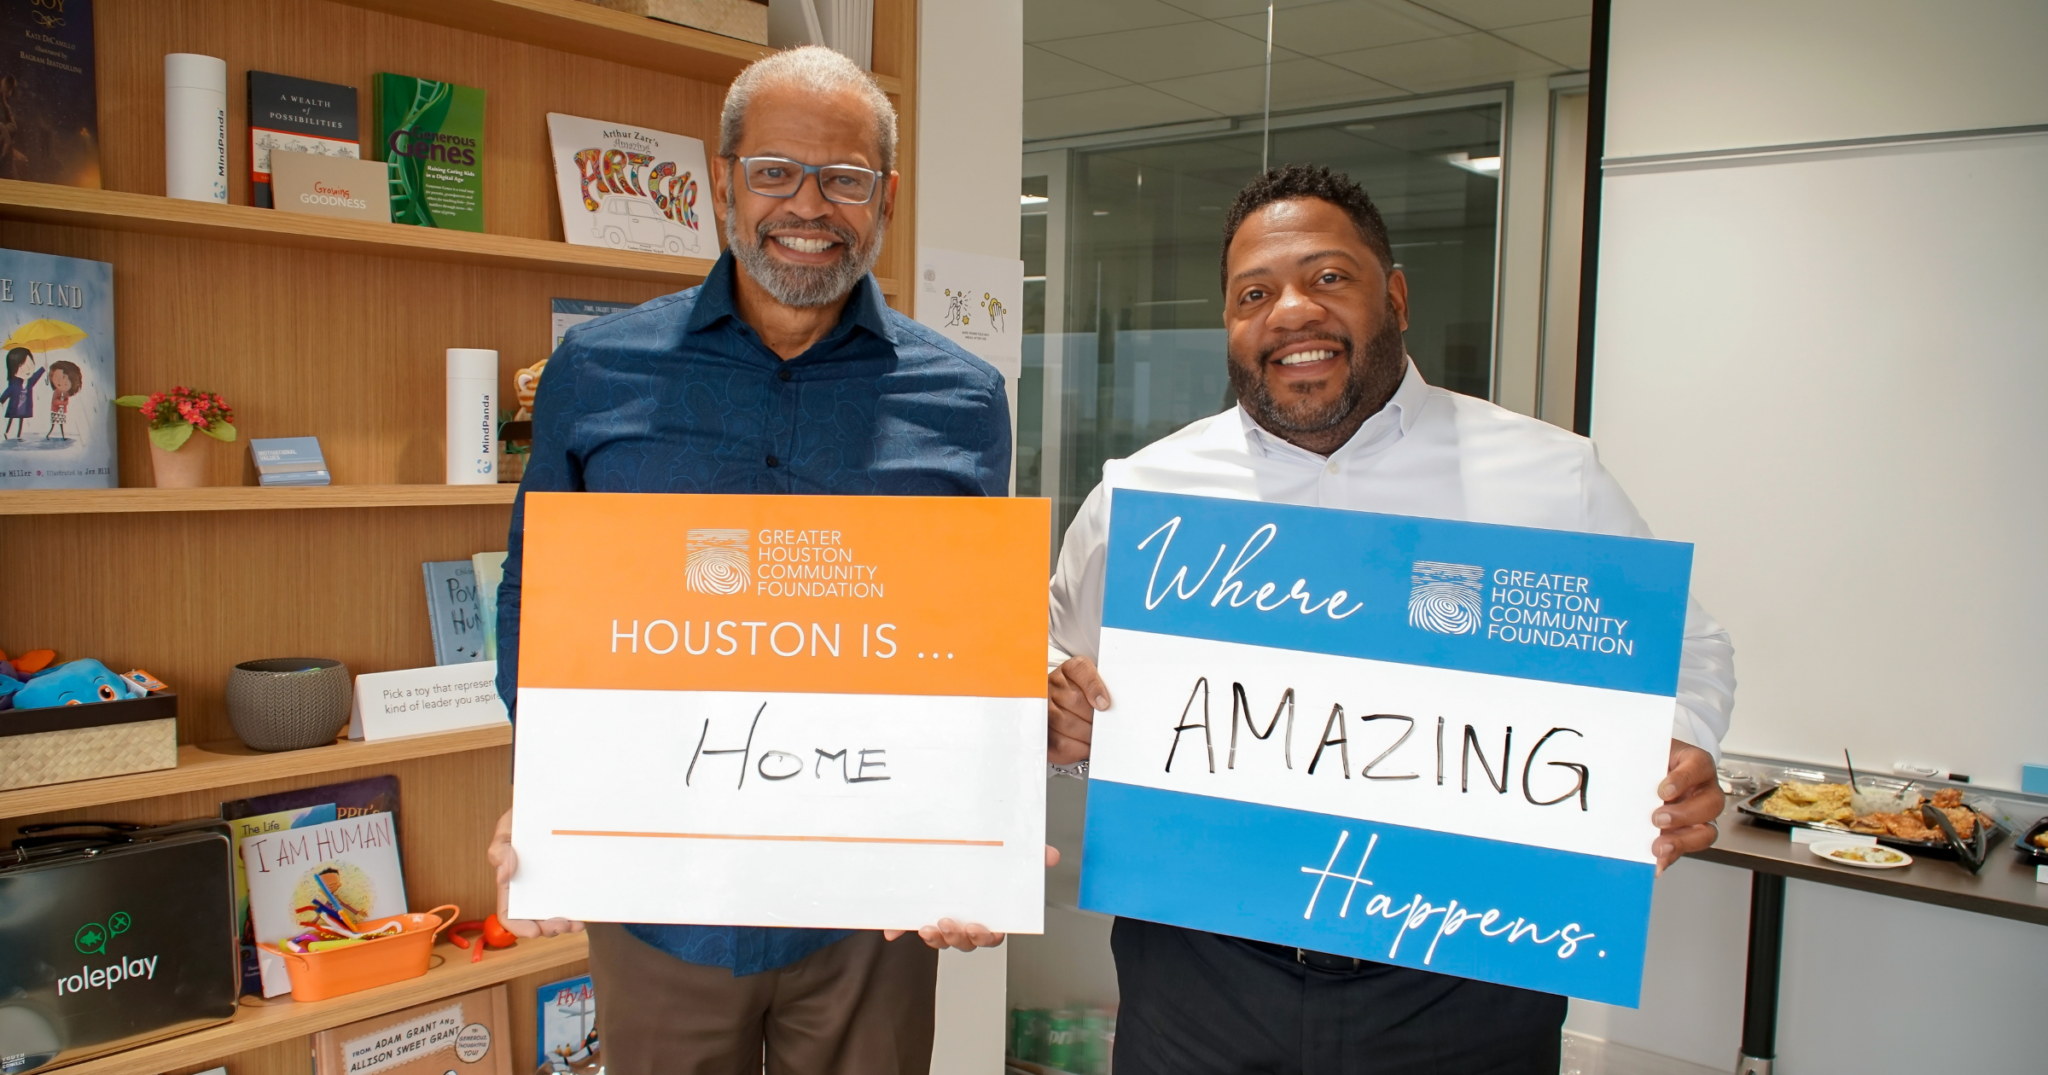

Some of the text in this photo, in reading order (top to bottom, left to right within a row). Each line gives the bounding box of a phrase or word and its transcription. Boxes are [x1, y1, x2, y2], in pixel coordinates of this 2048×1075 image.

[290, 95, 331, 108] WEALTH
[302, 107, 311, 115] of
[269, 112, 343, 129] POSSIBILITIES
[217, 110, 225, 177] MindPanda
[389, 129, 475, 166] Genes
[412, 125, 476, 147] Generous
[603, 130, 659, 148] Arthur Zarr's
[613, 138, 652, 154] Amazing
[300, 193, 367, 209] GOODNESS
[314, 181, 350, 199] Growing
[573, 148, 655, 212] ART
[648, 161, 699, 231] CAR
[29, 280, 83, 309] KIND
[482, 394, 490, 454] MindPanda
[85, 467, 96, 476] Jen
[757, 529, 842, 546] GREATER
[758, 546, 852, 563] HOUSTON
[757, 563, 878, 581] COMMUNITY
[1137, 516, 1364, 619] Where
[757, 581, 884, 598] FOUNDATION
[1493, 568, 1589, 594] GREATER
[1491, 587, 1600, 614] HOUSTON
[1489, 605, 1629, 635] COMMUNITY
[611, 618, 840, 658] HOUSTON
[862, 623, 898, 659] IS
[1487, 623, 1634, 656] FOUNDATION
[383, 679, 495, 700] Pick a toy that represen
[384, 703, 406, 714] kind
[409, 701, 420, 711] of
[422, 698, 452, 710] leader
[454, 697, 472, 708] you
[686, 701, 891, 790] HOME
[1165, 676, 1589, 811] AMAZING
[241, 820, 280, 835] The Life
[251, 817, 392, 873] I AM HUMAN
[1301, 830, 1606, 965] Happens.
[57, 955, 158, 996] roleplay
[556, 987, 578, 1007] Fly
[350, 1026, 460, 1073] ALLISON SWEET GRANT
[352, 1018, 455, 1058] FROM ADAM GRANT AND
[1, 1053, 25, 1062] YOUTH
